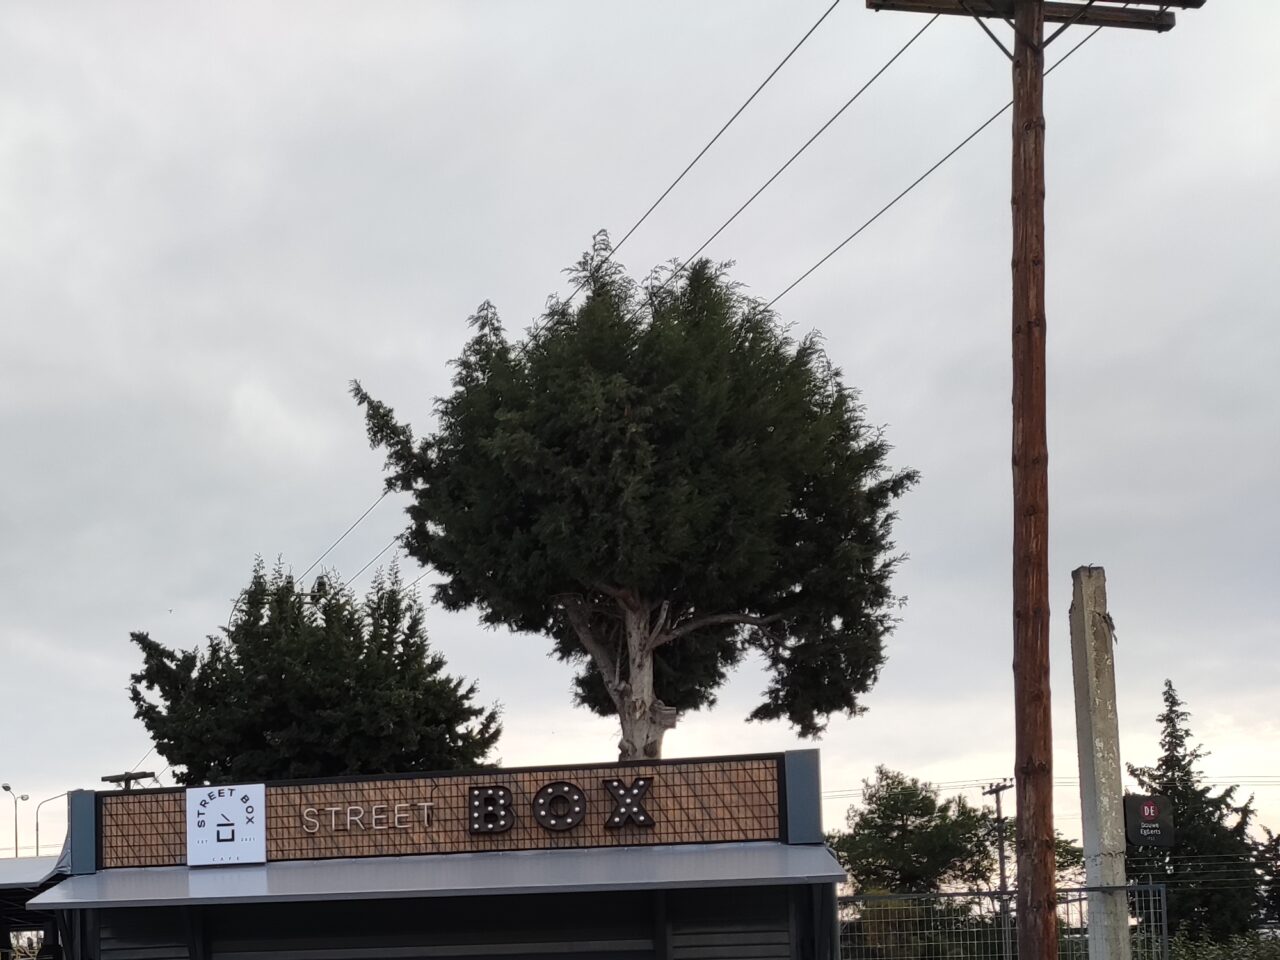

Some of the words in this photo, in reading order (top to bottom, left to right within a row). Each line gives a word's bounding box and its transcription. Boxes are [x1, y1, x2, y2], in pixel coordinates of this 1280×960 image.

[197, 788, 236, 828] STREET
[240, 794, 255, 825] BOX
[302, 802, 435, 833] STREET
[469, 776, 656, 834] BOX
[1144, 806, 1155, 816] DE
